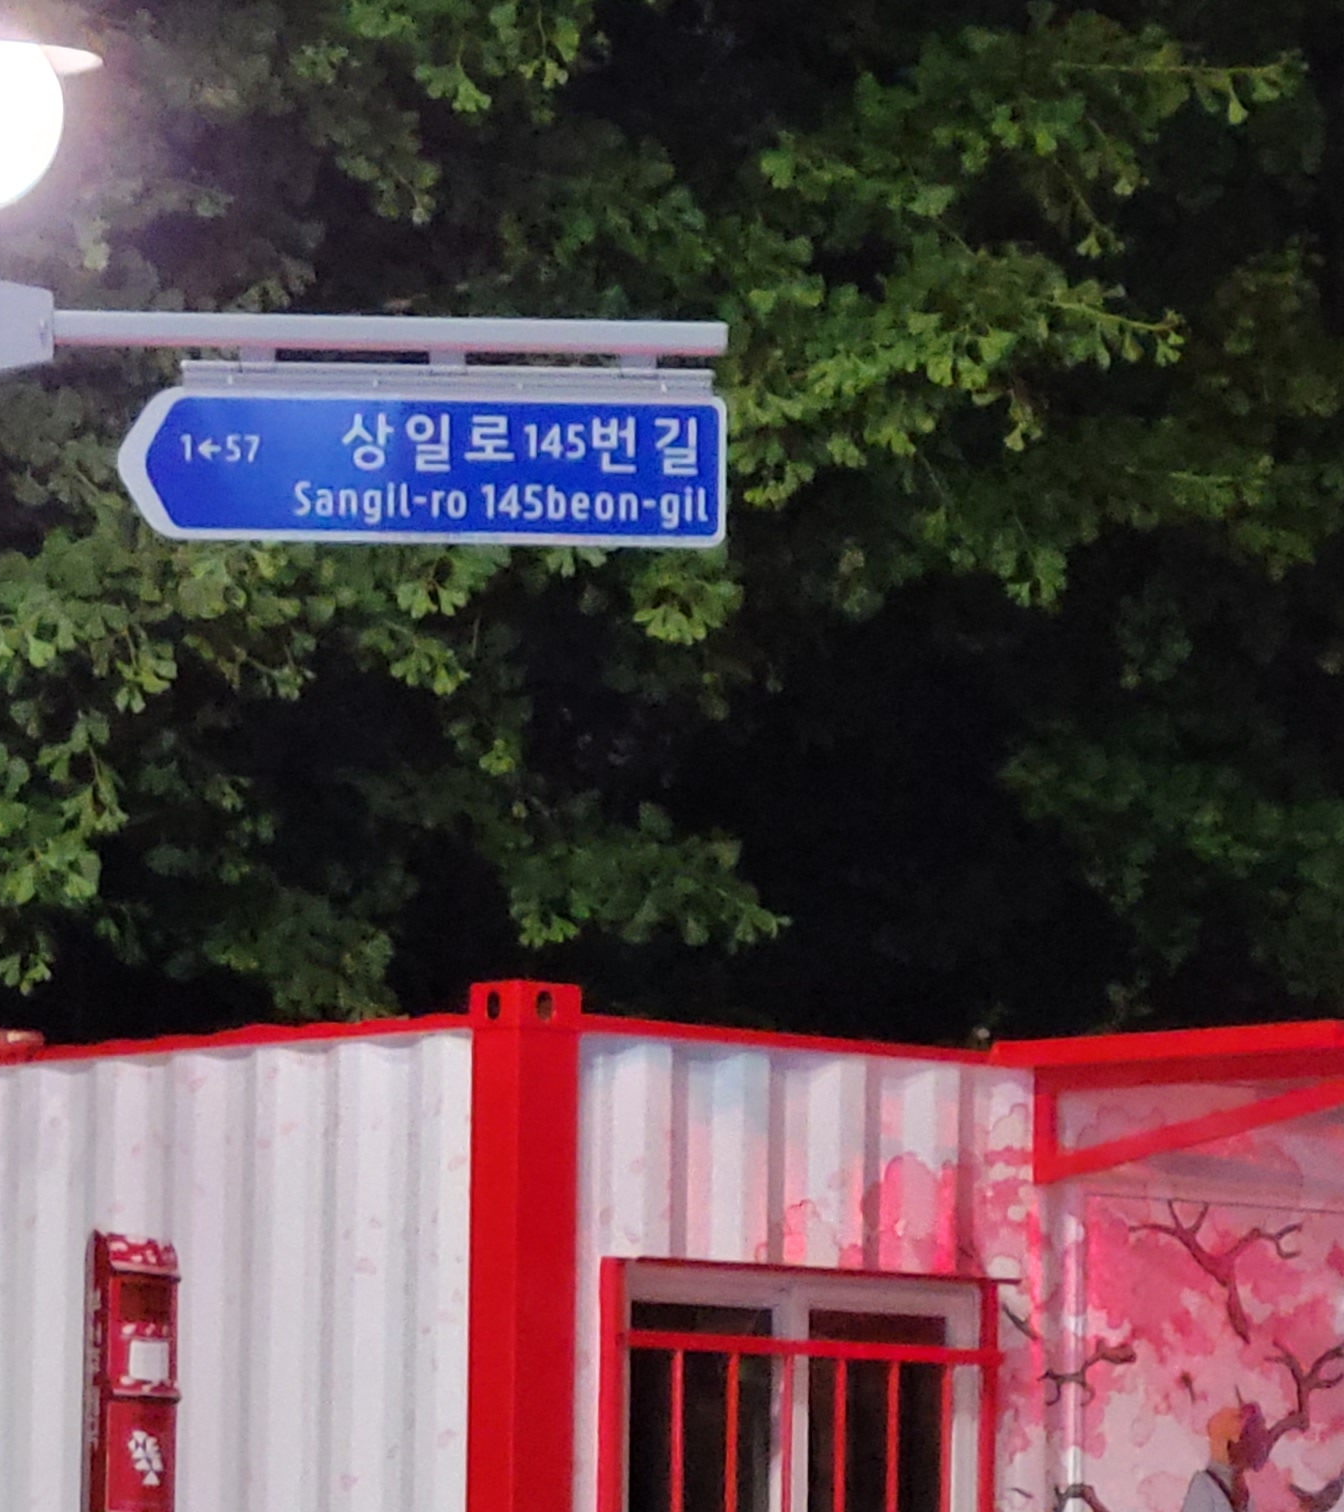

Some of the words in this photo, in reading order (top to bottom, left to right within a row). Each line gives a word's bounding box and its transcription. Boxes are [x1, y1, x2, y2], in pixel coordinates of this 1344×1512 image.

[342, 412, 700, 477] 상일로145번길
[293, 480, 468, 526] Sangil-ro
[482, 482, 710, 531] 145beon-gil
